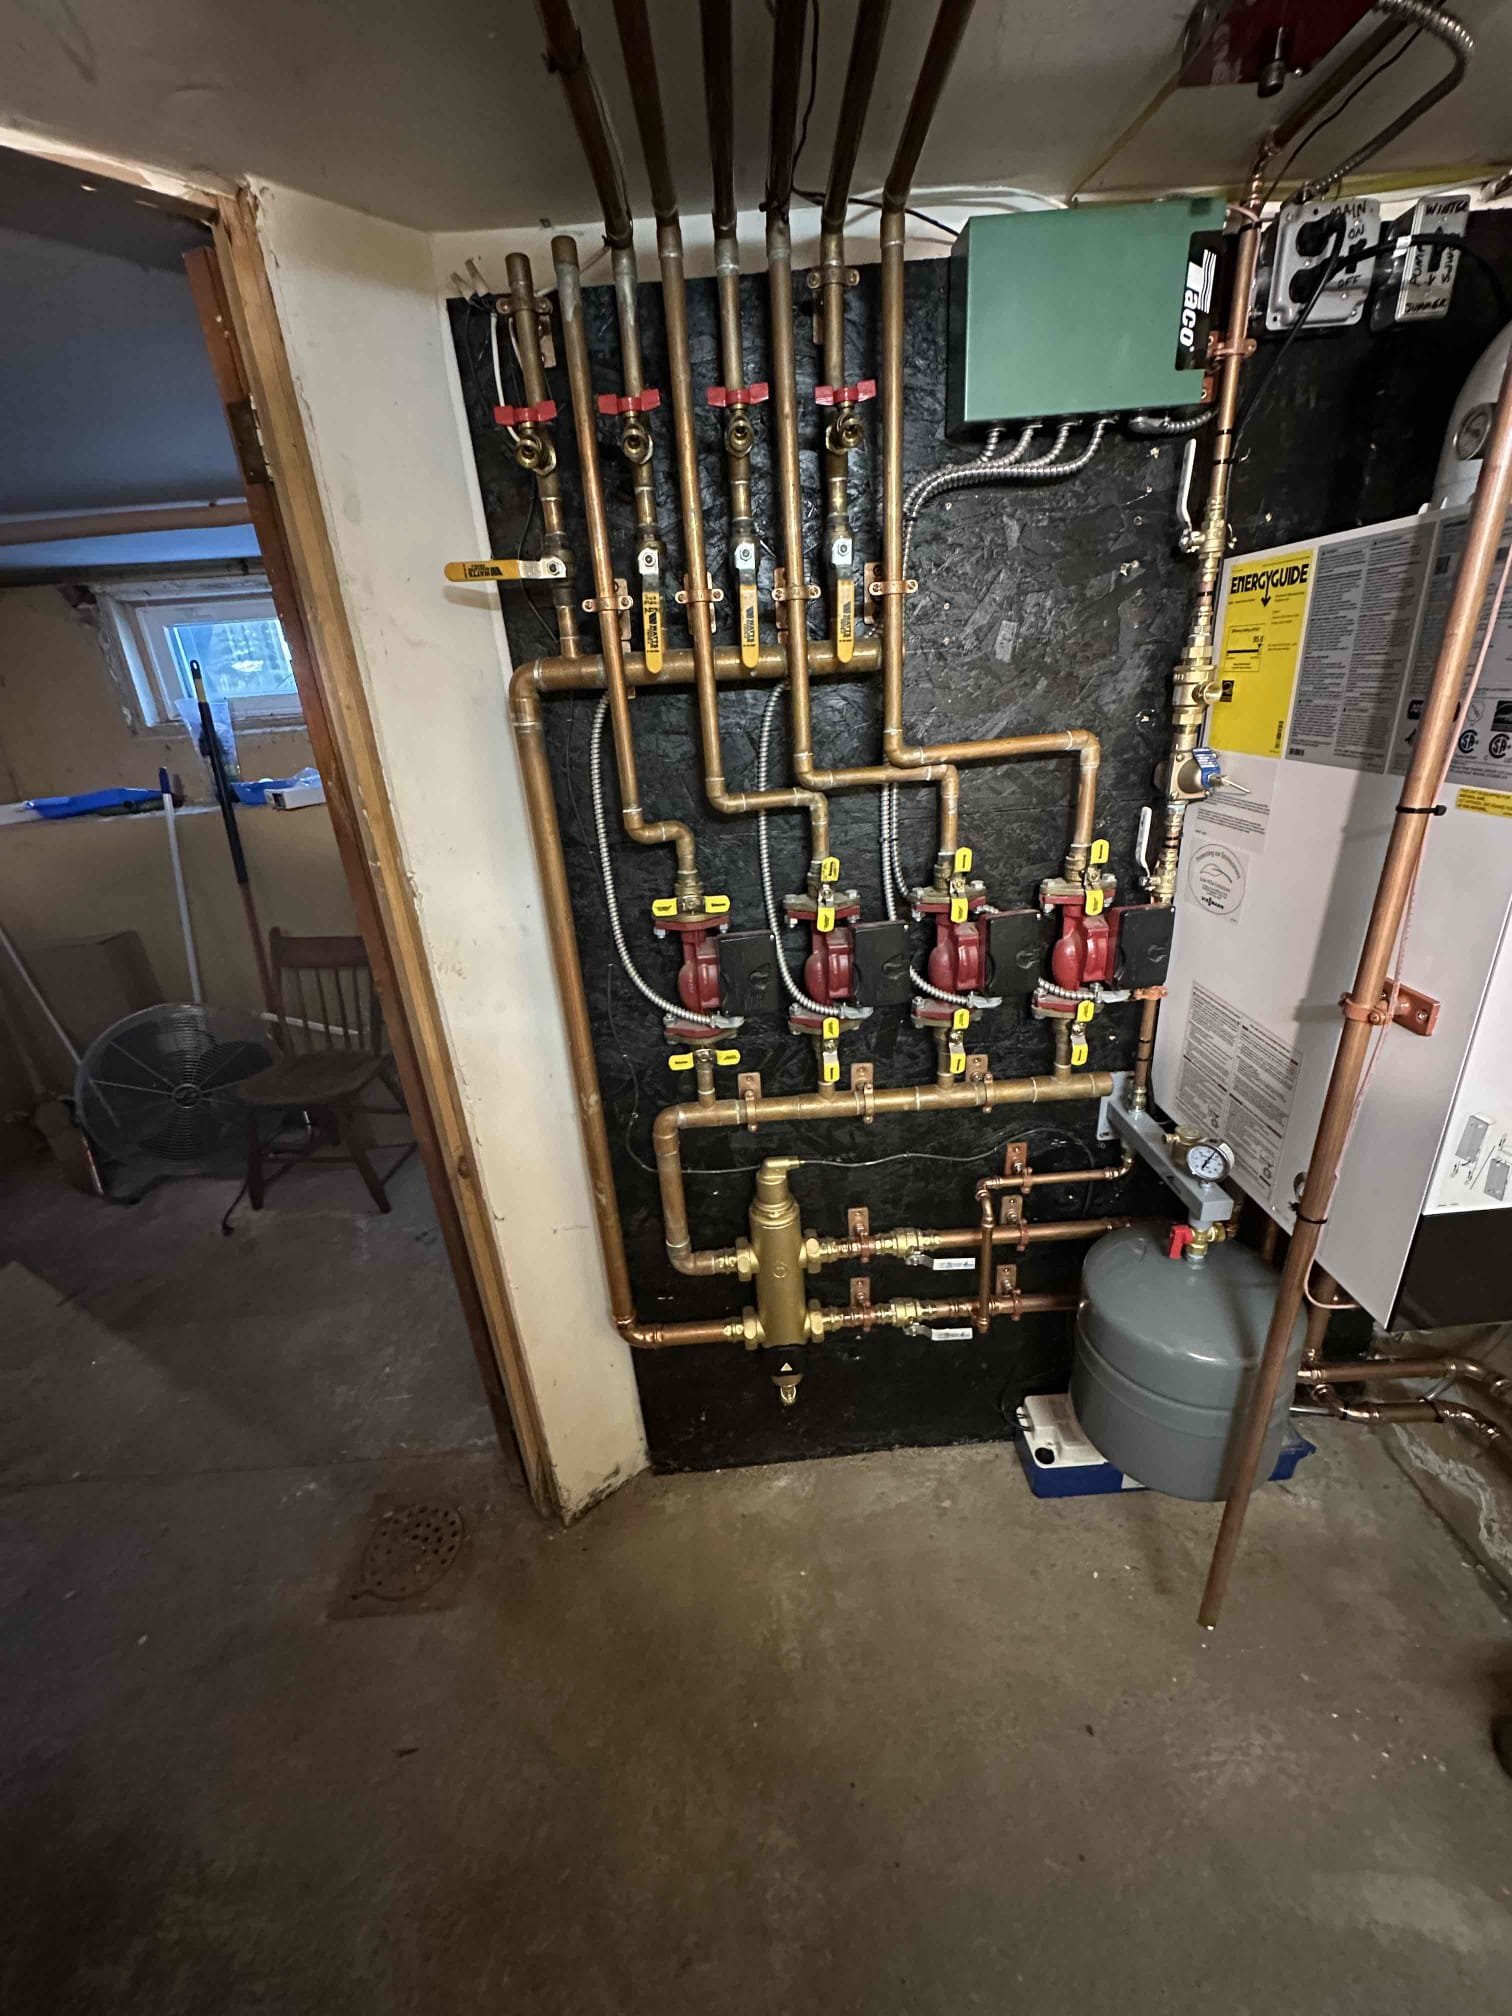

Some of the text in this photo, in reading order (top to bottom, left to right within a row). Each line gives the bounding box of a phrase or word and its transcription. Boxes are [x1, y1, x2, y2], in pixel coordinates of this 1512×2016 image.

[1330, 200, 1367, 218] MAIN
[1348, 224, 1365, 239] ON
[1337, 274, 1361, 288] OFF
[1405, 298, 1447, 313] SUMMER
